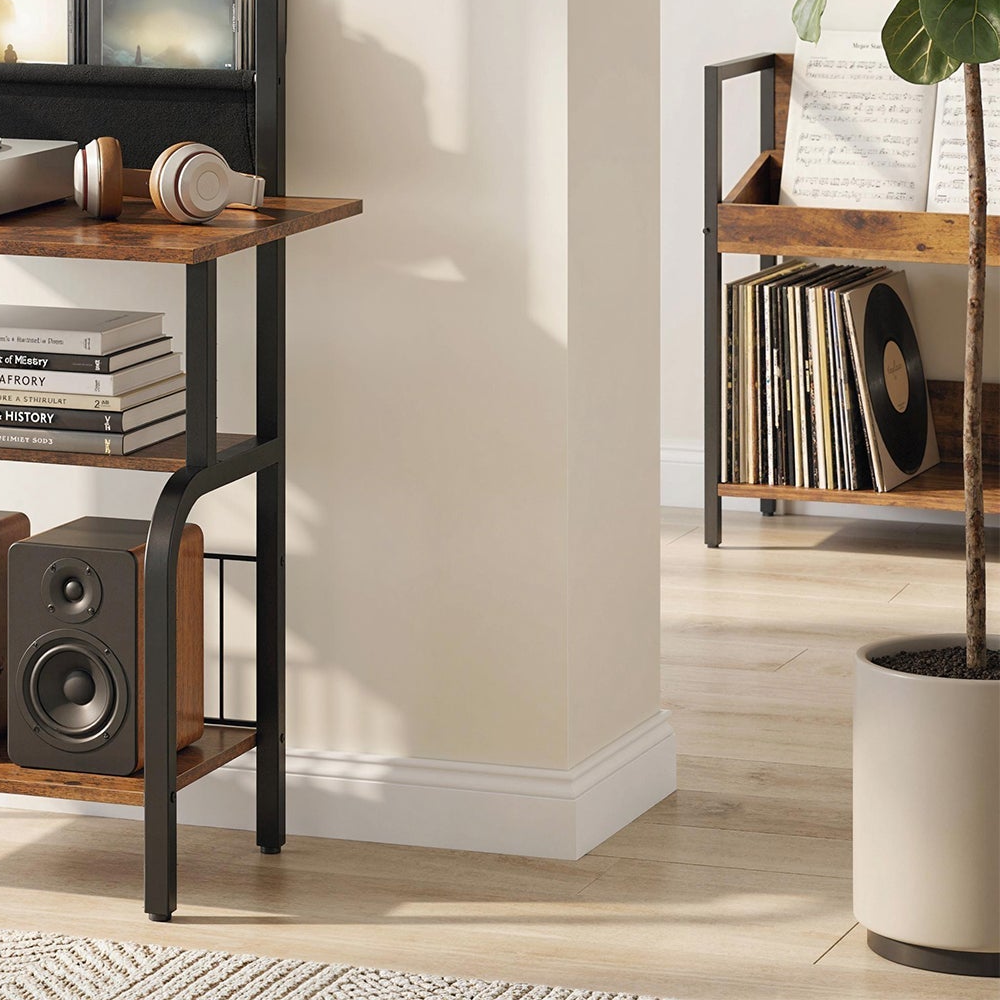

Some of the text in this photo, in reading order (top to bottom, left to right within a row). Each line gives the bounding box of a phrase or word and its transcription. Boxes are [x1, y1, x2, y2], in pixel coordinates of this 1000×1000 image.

[4, 354, 14, 364] of
[94, 399, 100, 409] 2
[5, 410, 55, 424] HISTORY
